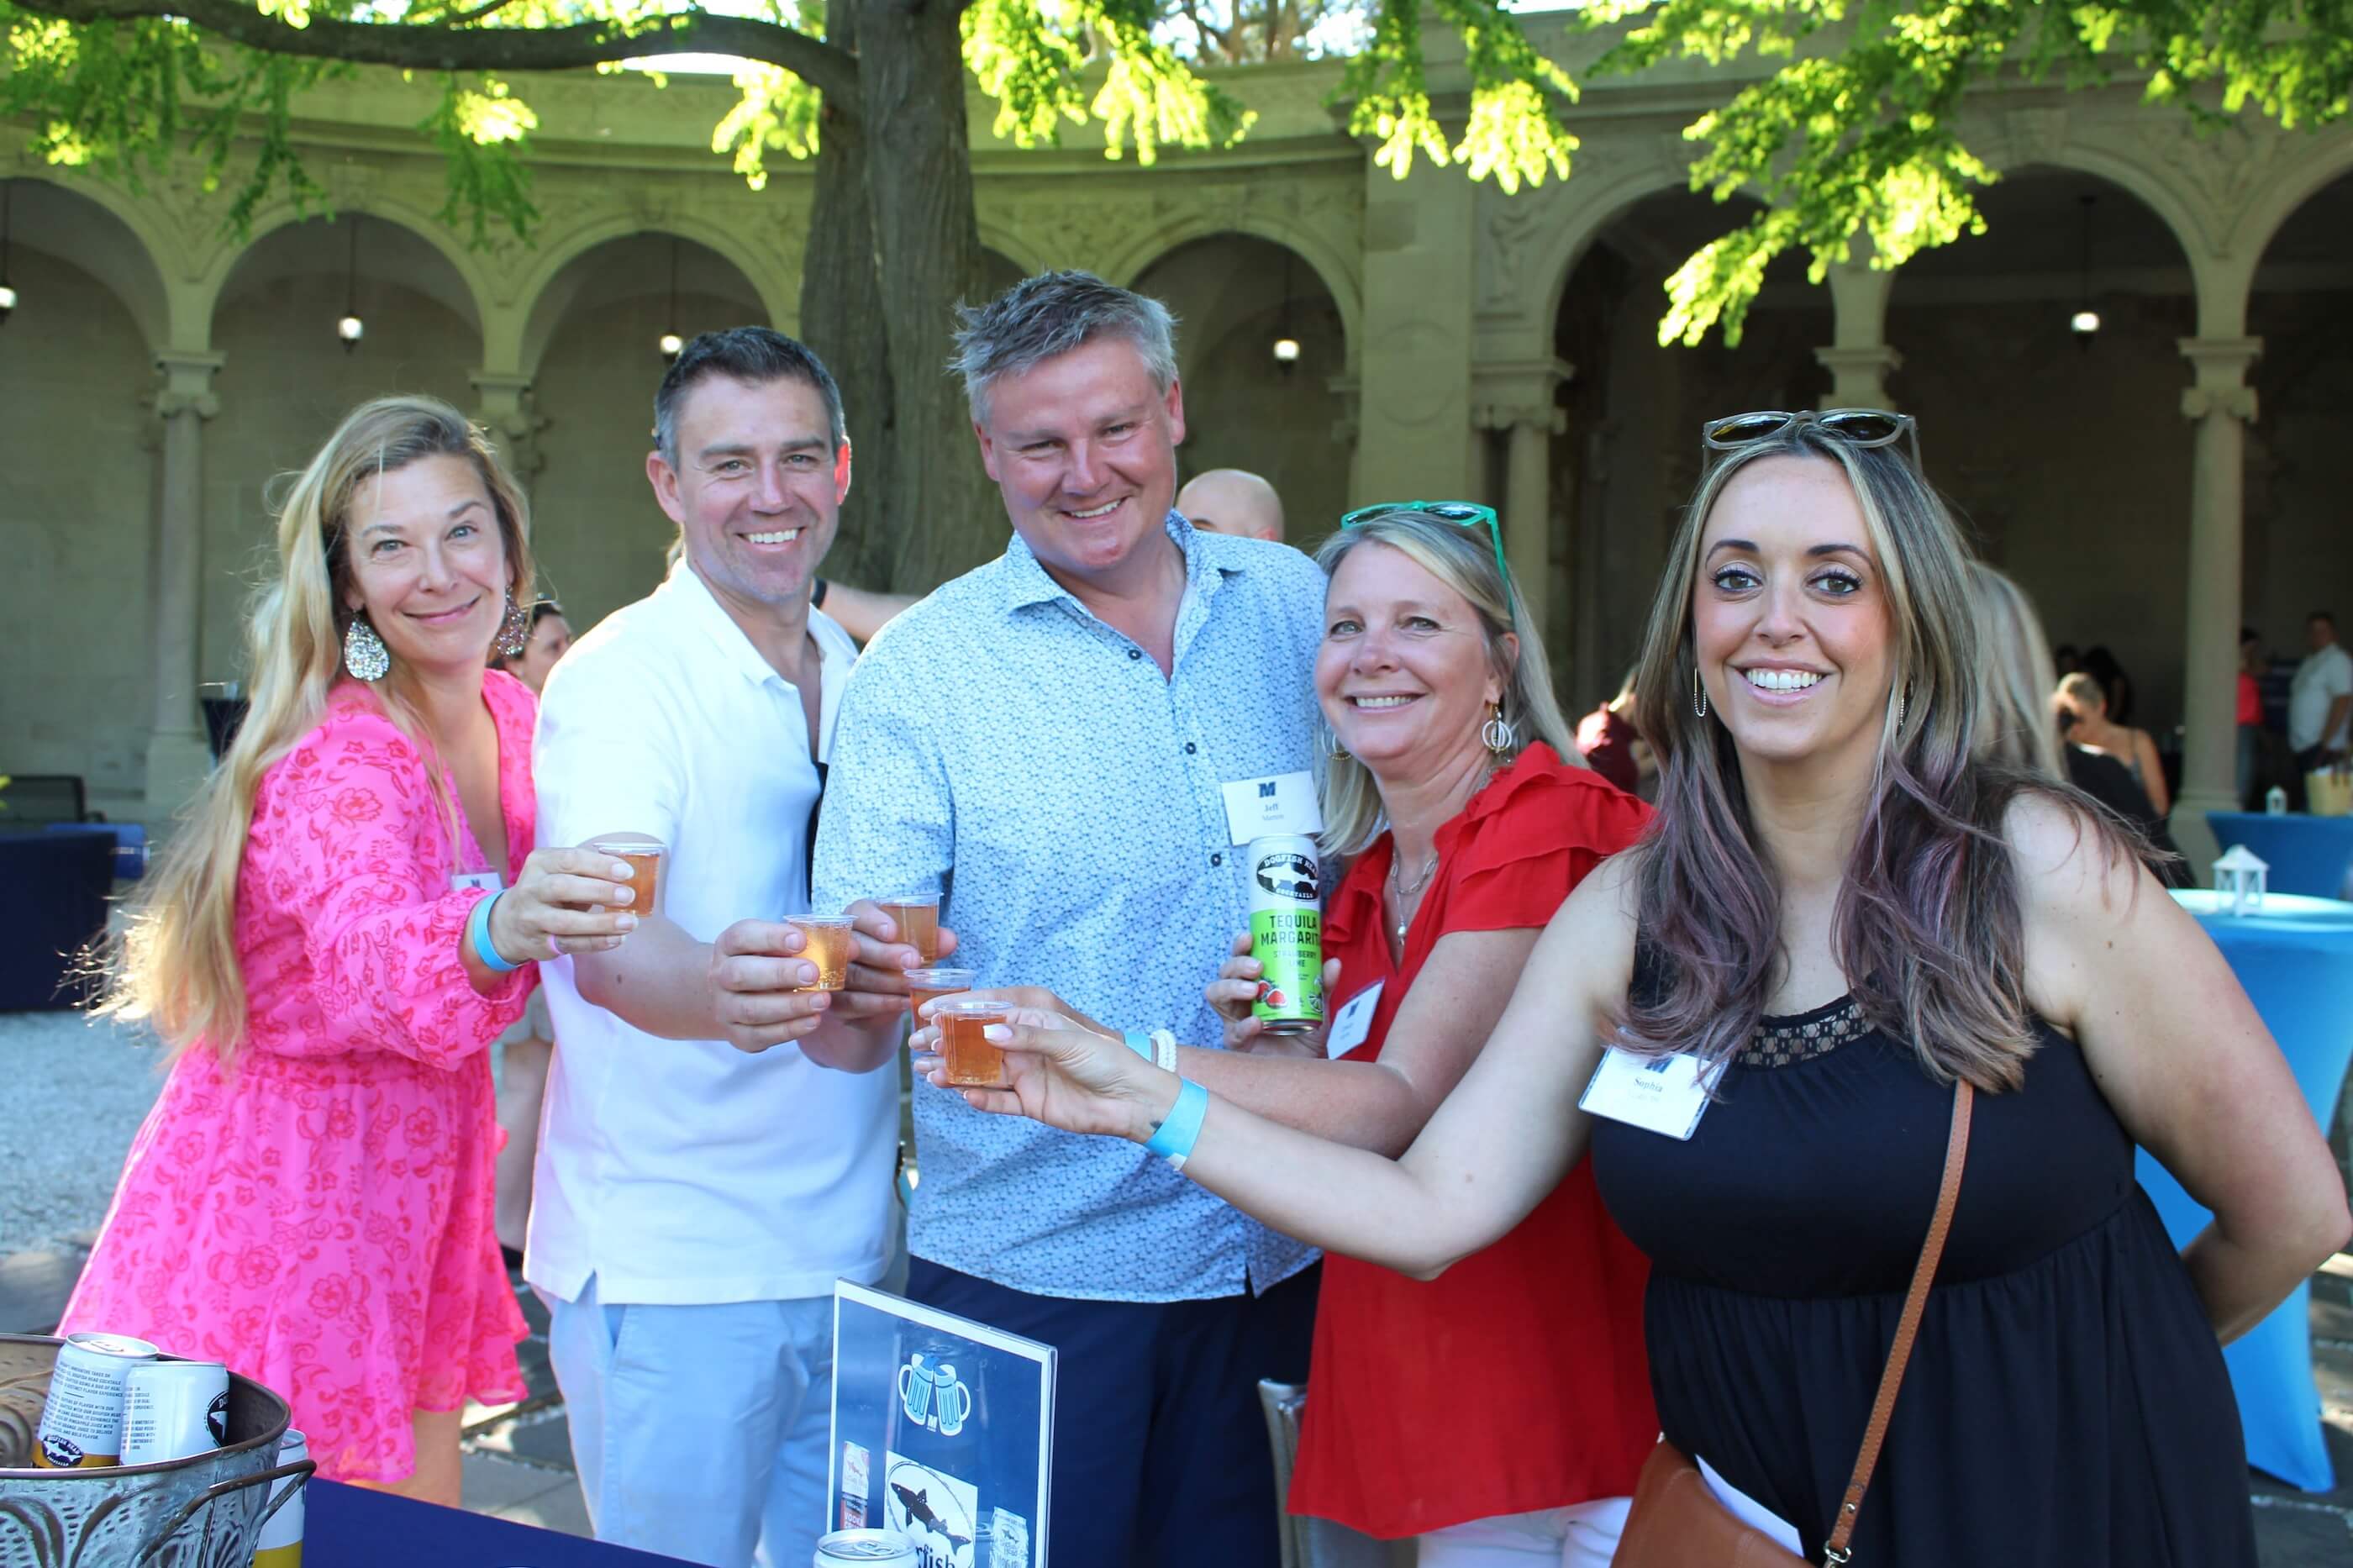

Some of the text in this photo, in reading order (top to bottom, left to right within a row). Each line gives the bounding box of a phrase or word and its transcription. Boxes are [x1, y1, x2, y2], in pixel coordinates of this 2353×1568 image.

[1264, 855, 1303, 866] DOGFISH
[1269, 914, 1317, 929] TEQUILA
[1261, 930, 1319, 946] MARGARIT
[1634, 1076, 1663, 1092] Sophia
[915, 1544, 955, 1568] fish
